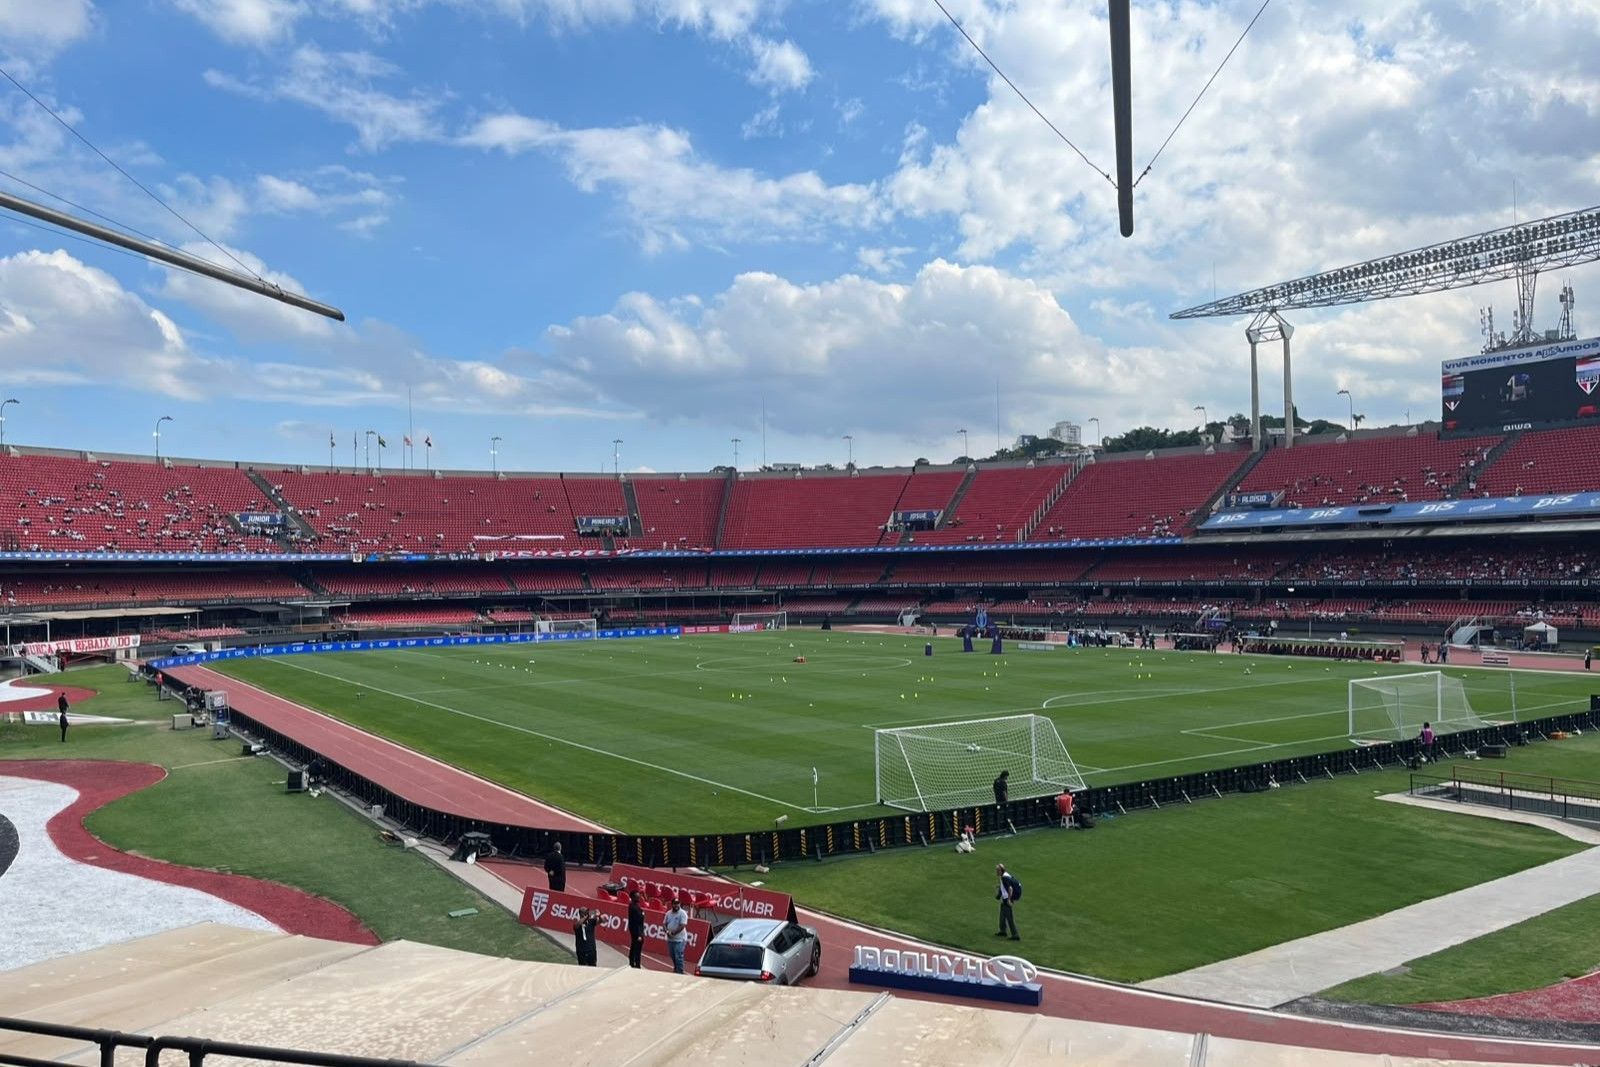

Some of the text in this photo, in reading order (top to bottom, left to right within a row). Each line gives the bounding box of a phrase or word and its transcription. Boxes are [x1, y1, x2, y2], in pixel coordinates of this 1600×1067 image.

[1445, 361, 1469, 369] VIVA
[1471, 352, 1532, 366] MOMENTOS
[1503, 423, 1532, 431] aiwa
[76, 637, 130, 650] REBAIXDO
[551, 904, 580, 921] SEJA
